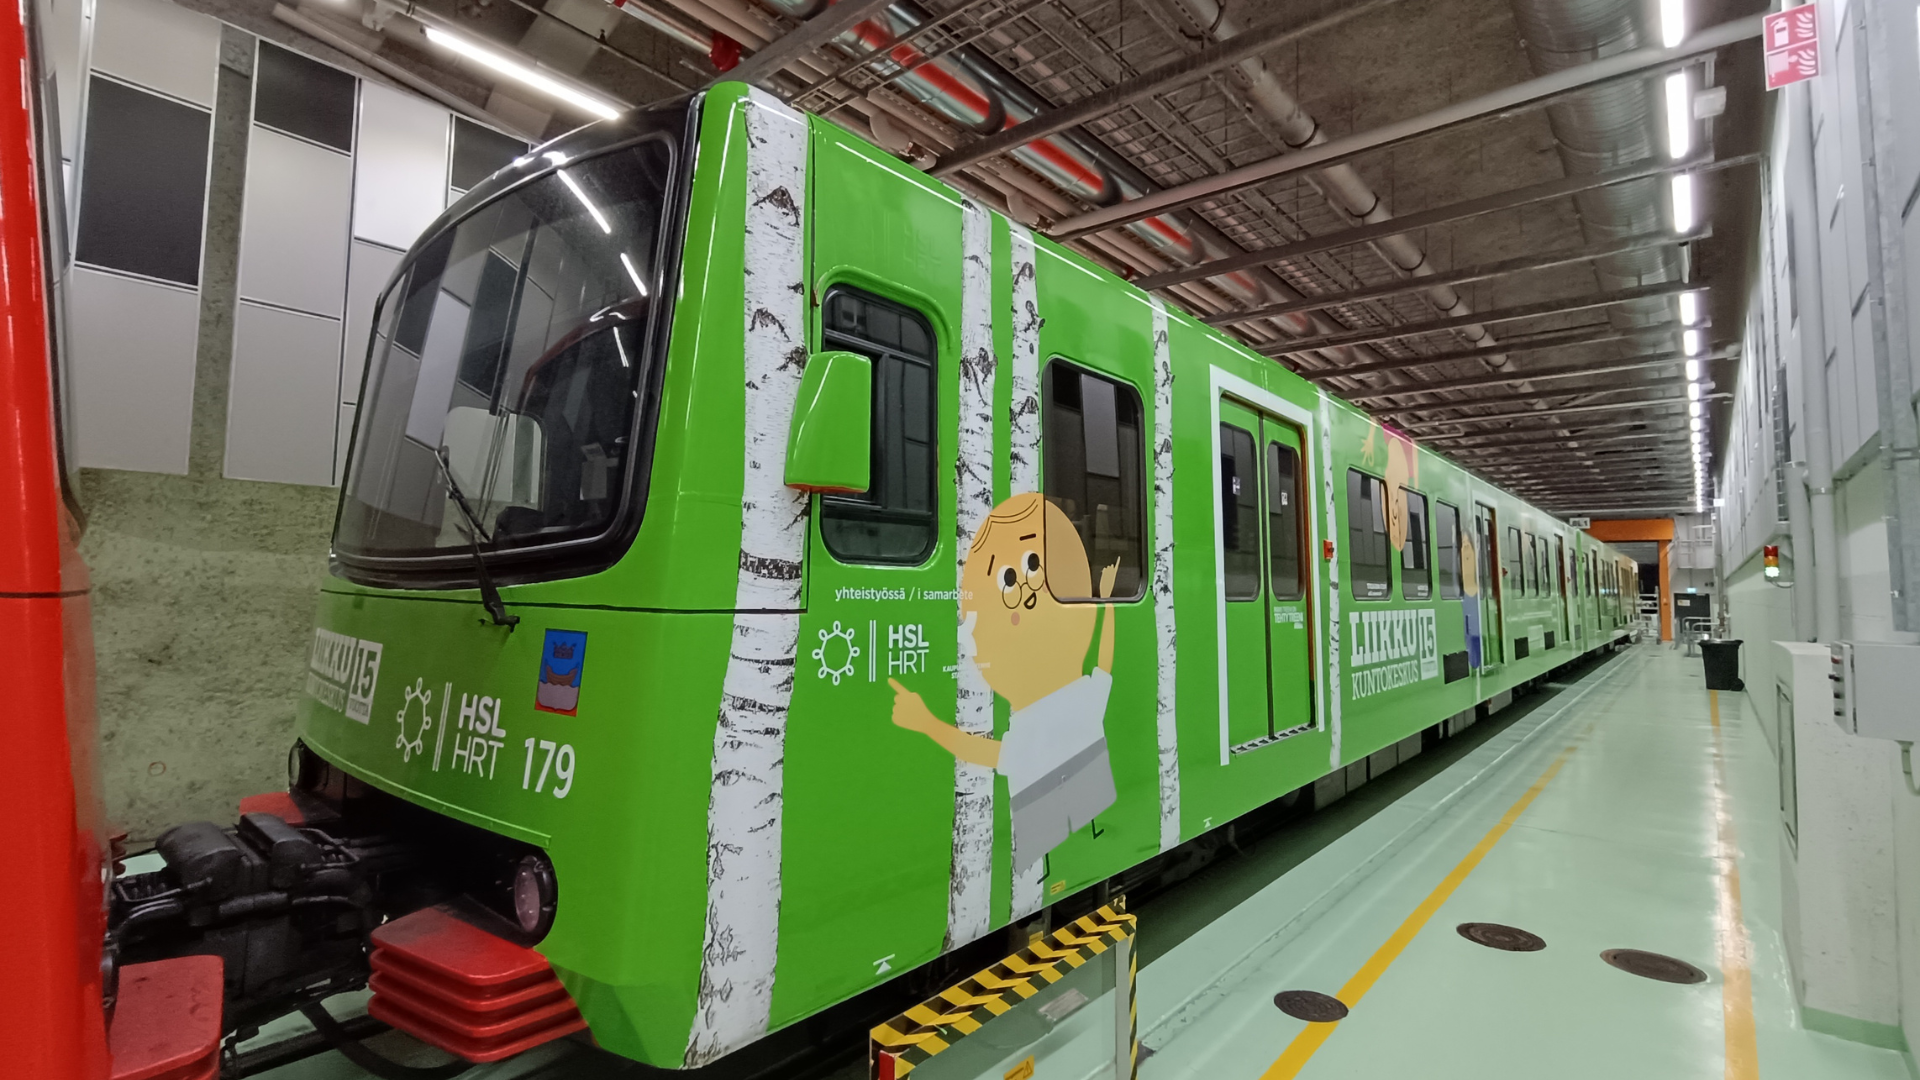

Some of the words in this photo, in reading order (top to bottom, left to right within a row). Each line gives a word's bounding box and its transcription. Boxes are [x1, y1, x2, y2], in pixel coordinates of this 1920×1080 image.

[835, 586, 906, 602] yhteistyössä
[908, 586, 916, 602] /
[917, 588, 921, 600] i
[923, 588, 974, 600] samarbete
[888, 623, 930, 649] HSL
[1349, 609, 1417, 667] LIIKKU
[1420, 616, 1435, 659] 15
[351, 647, 378, 699] 15
[888, 649, 930, 676] HRT
[1351, 659, 1419, 701] KUNTOKESKUS
[458, 692, 506, 738] HSL
[451, 733, 505, 780] HRT
[522, 737, 576, 799] 179
